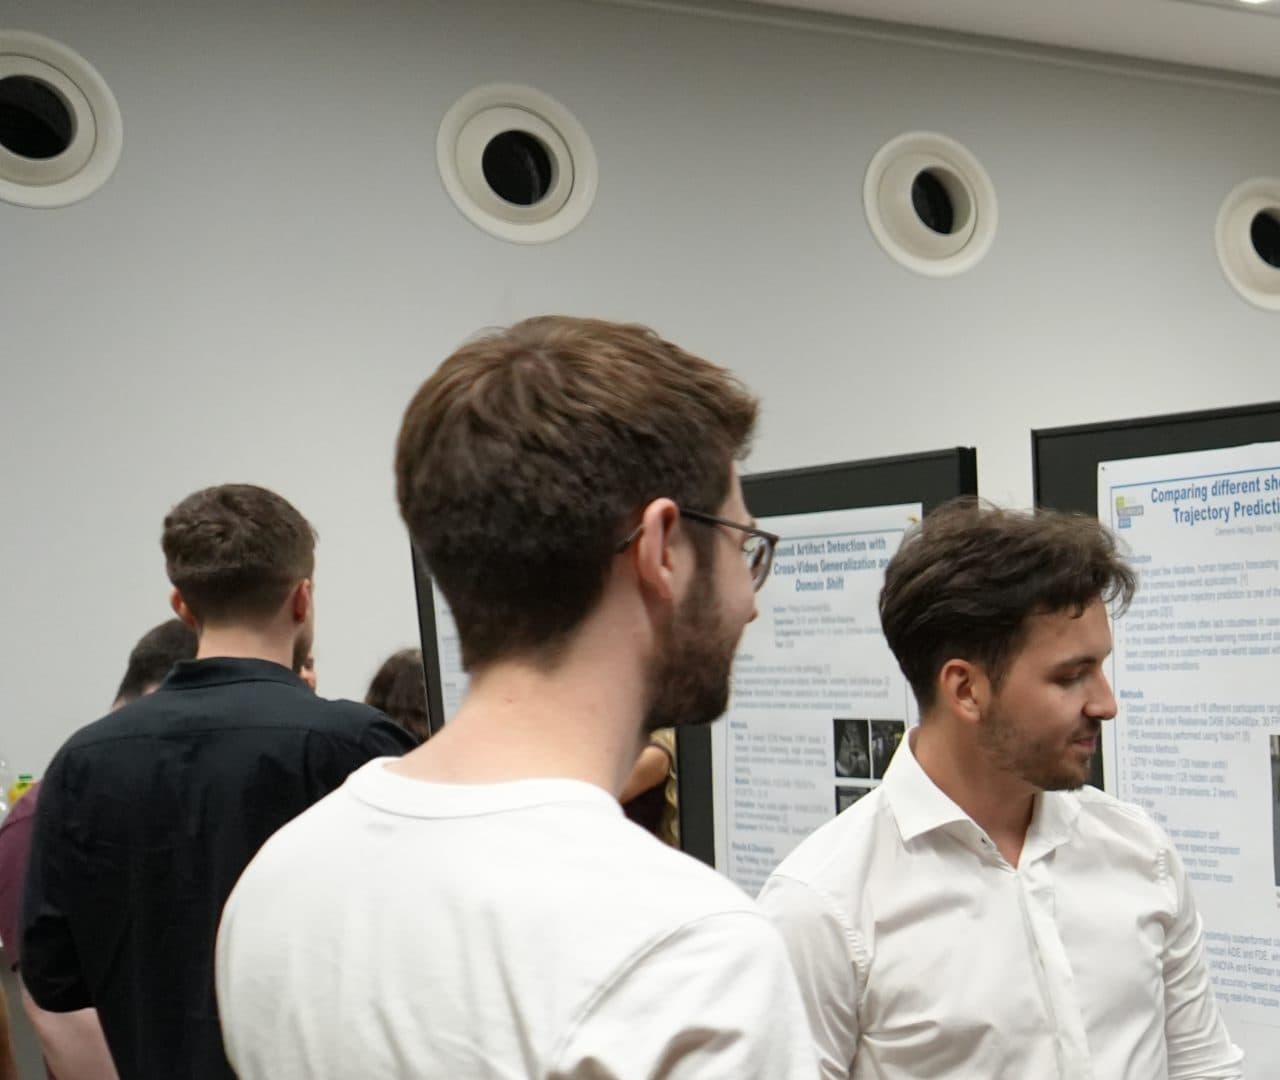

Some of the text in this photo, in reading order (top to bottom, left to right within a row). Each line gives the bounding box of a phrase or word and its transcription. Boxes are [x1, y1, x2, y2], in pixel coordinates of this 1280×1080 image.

[1150, 483, 1207, 505] Comparing
[1210, 476, 1260, 497] different
[1172, 505, 1230, 525] Trajectory
